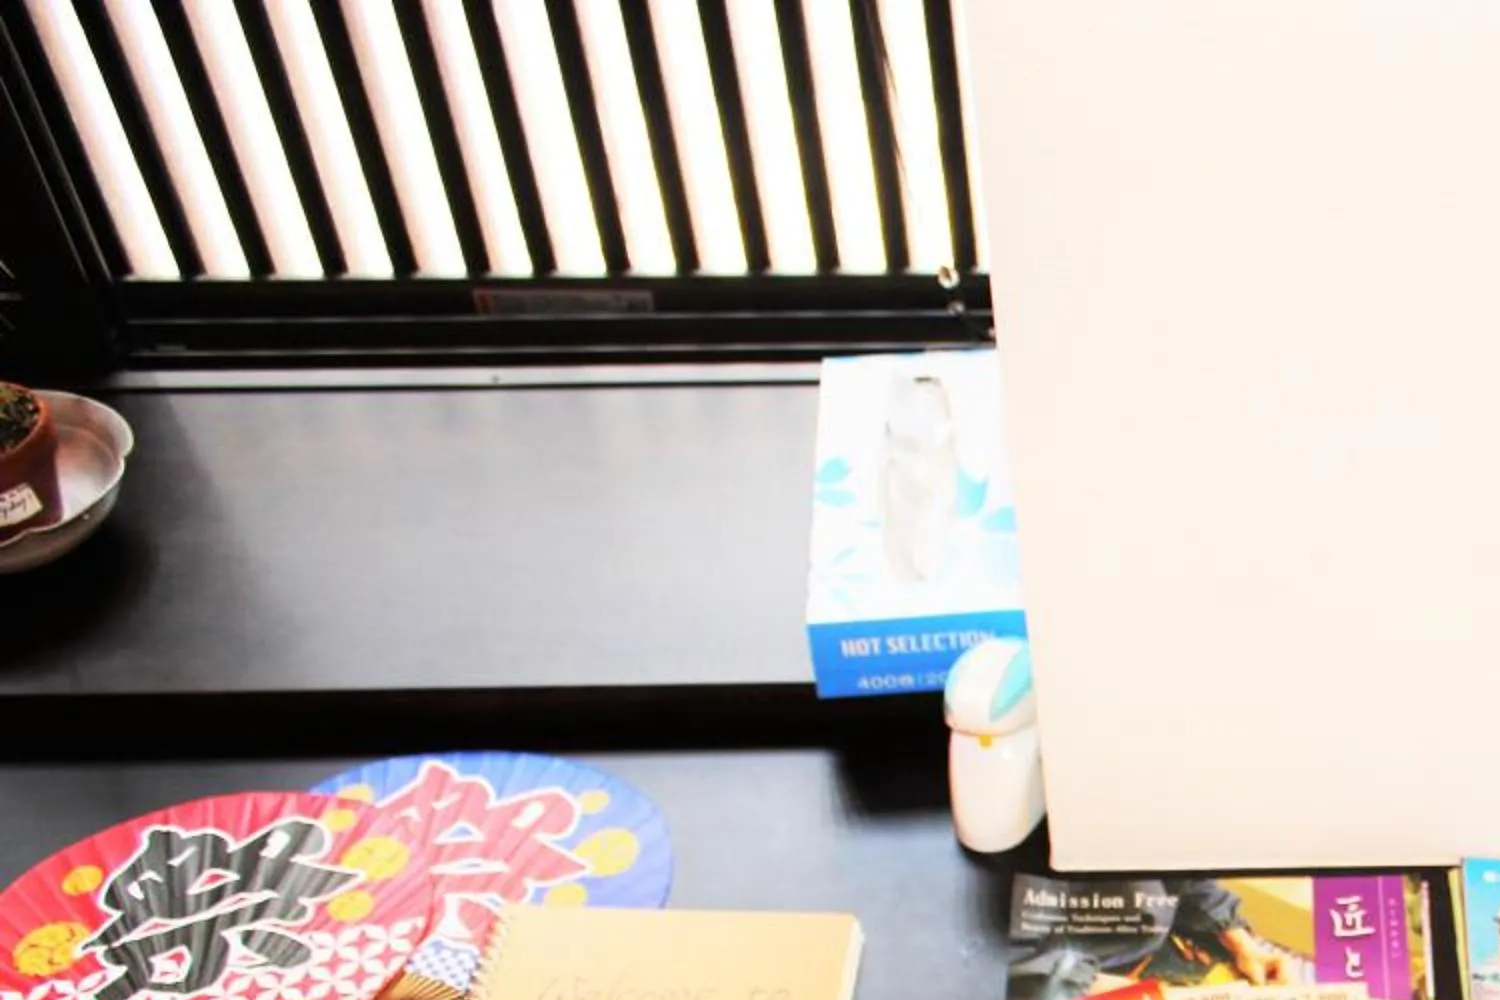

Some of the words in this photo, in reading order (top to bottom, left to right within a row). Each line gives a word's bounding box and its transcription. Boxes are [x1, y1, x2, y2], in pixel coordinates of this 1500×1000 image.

[841, 637, 881, 657] HOT
[1023, 889, 1125, 909] Admission
[1134, 891, 1179, 908] Free
